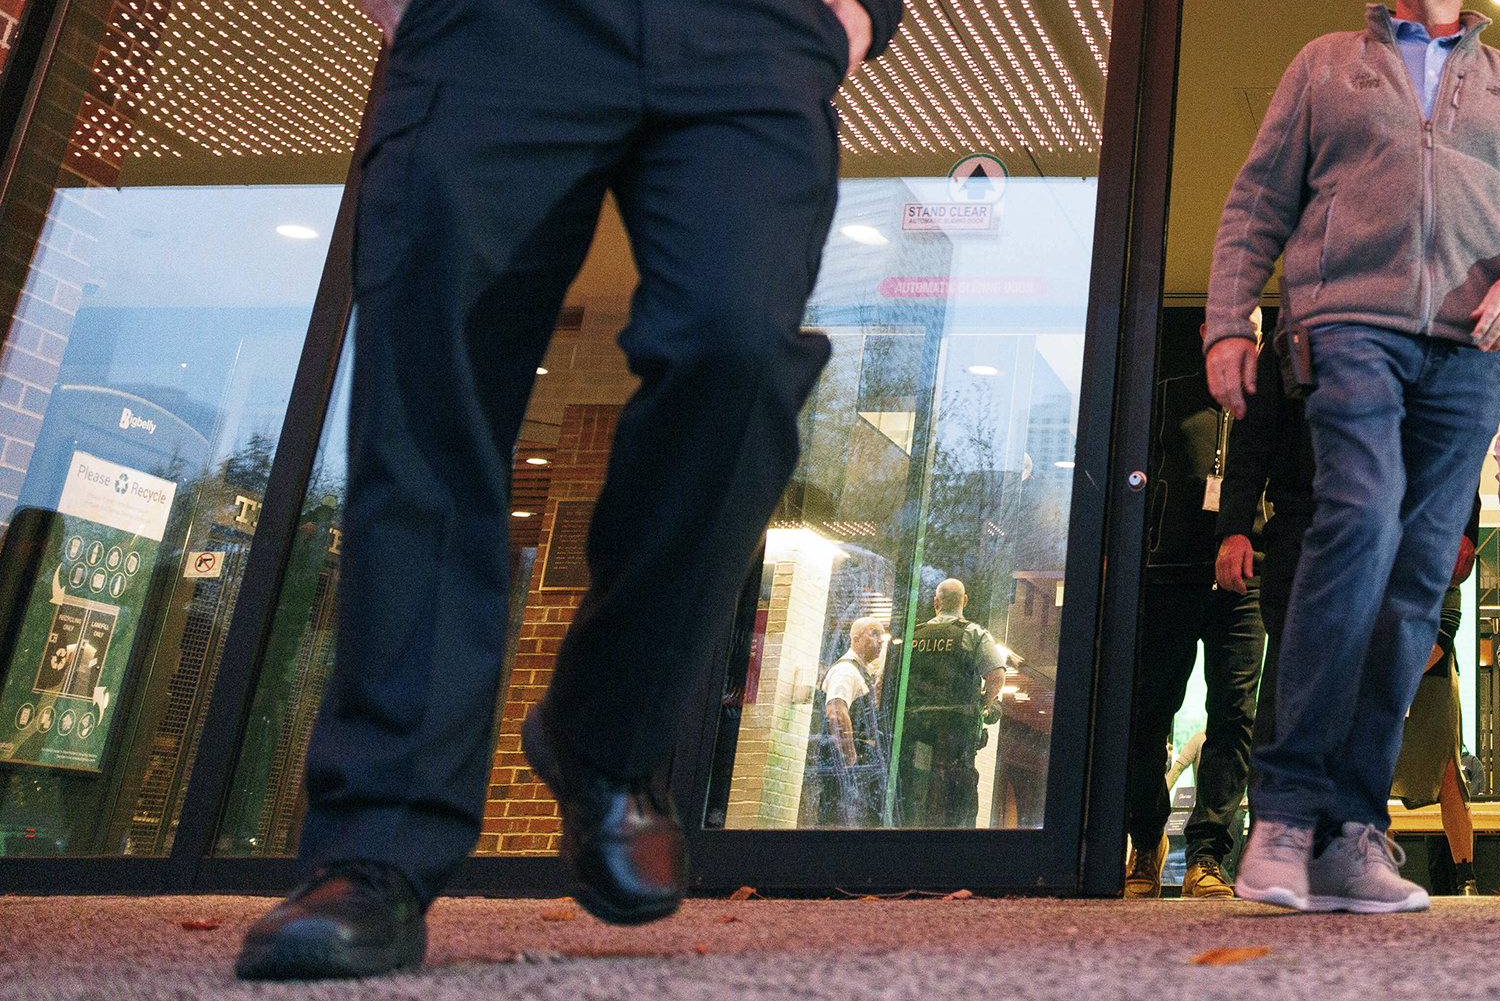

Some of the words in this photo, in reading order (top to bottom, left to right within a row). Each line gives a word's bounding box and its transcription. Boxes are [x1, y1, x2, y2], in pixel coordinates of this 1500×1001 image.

[908, 206, 946, 217] STAND
[950, 206, 987, 217] CLEAR
[119, 408, 157, 434] Bigbelly
[77, 464, 111, 486] Please
[131, 482, 166, 504] Recycle
[912, 639, 953, 652] POLICE
